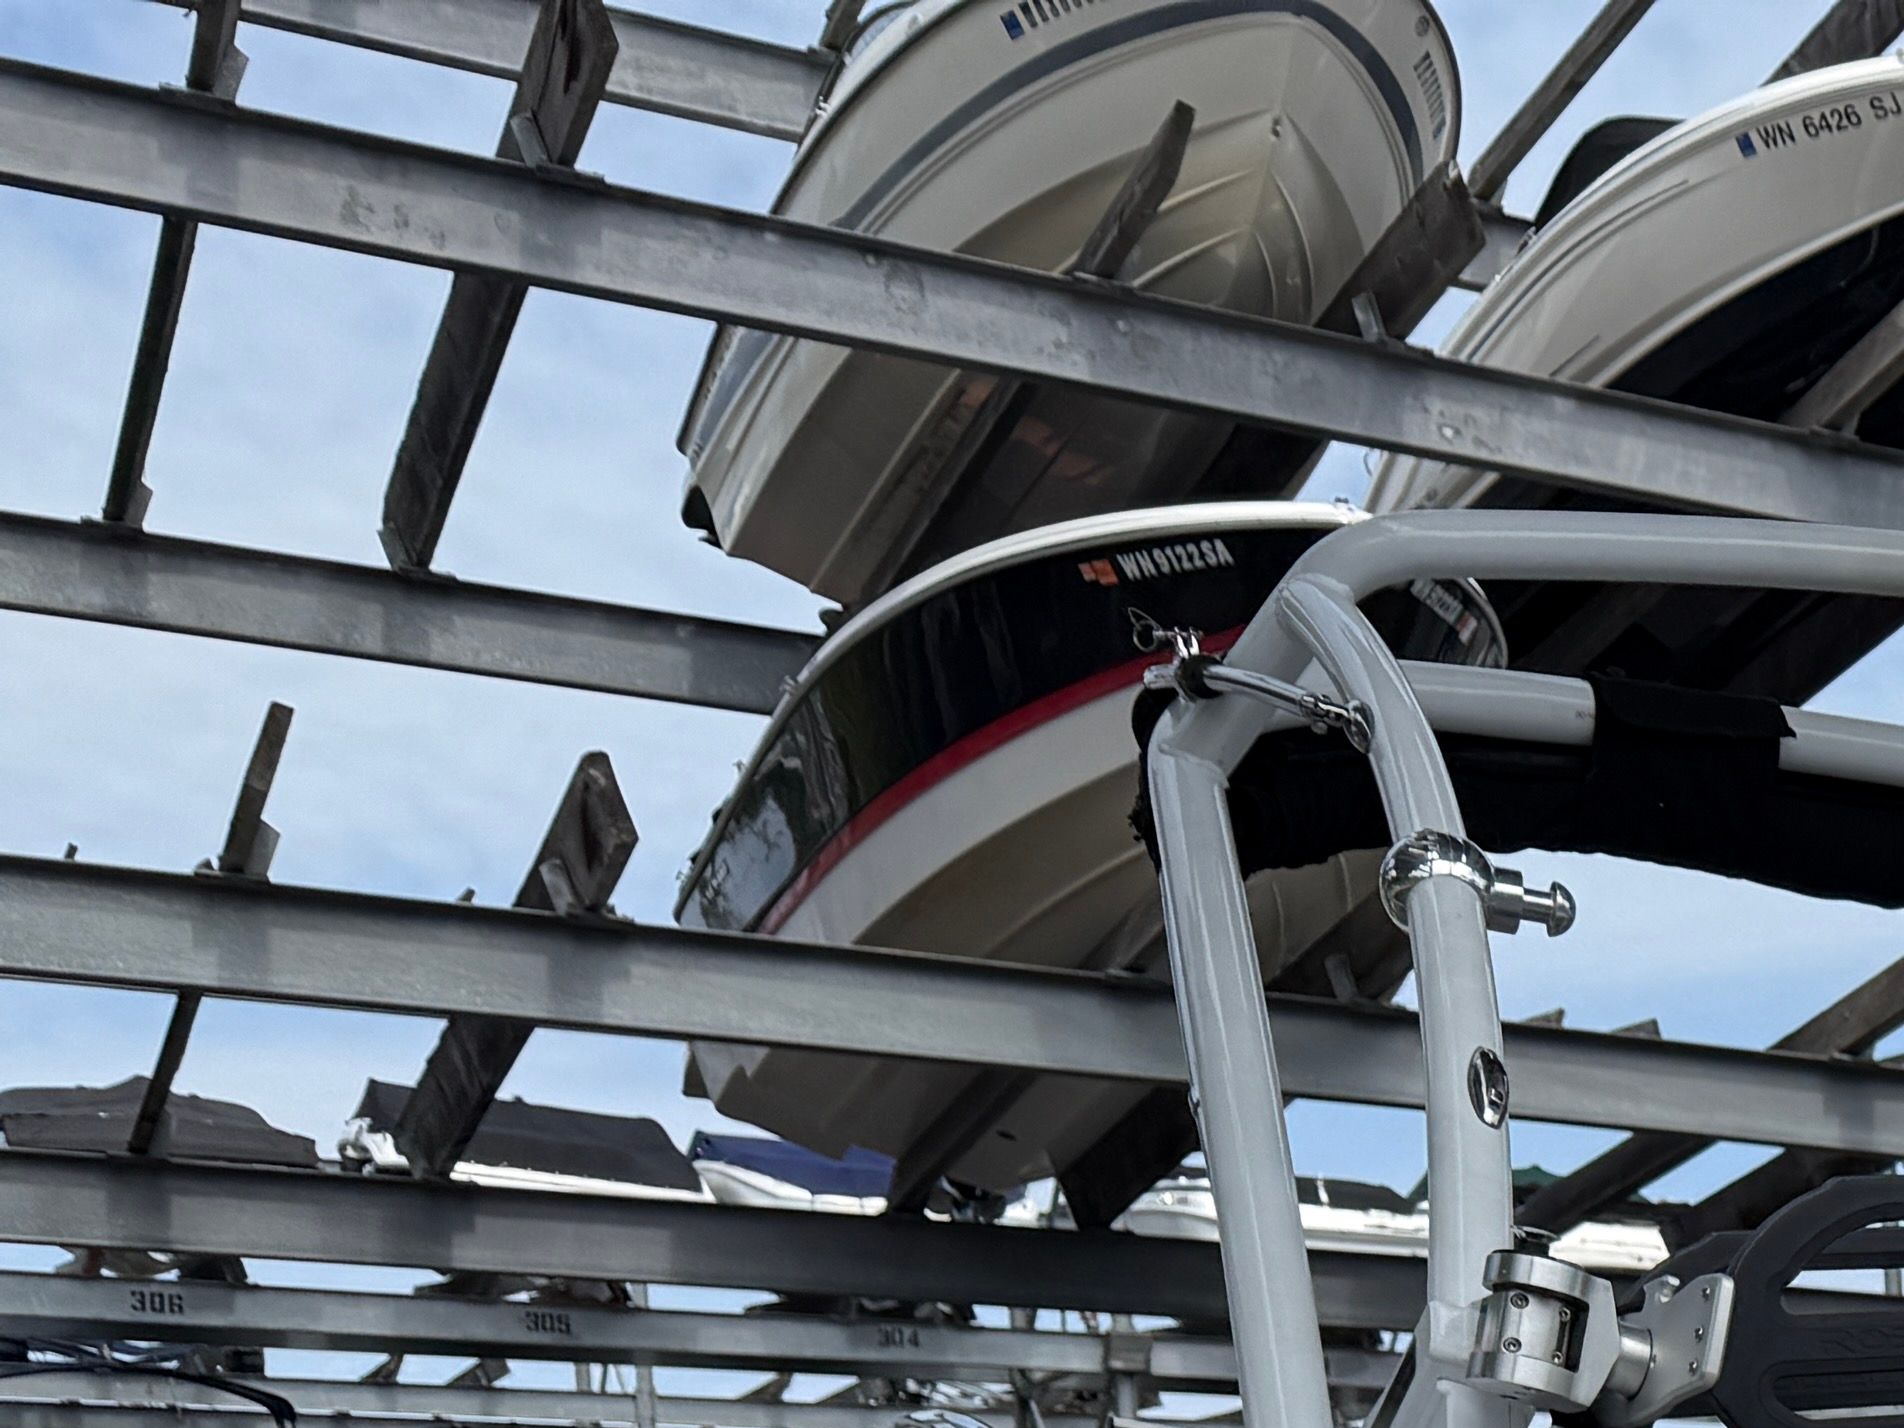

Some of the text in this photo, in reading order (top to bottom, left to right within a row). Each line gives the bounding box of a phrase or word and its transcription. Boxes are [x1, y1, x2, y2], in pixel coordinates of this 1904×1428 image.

[1756, 91, 1902, 149] WN 6426 SJ
